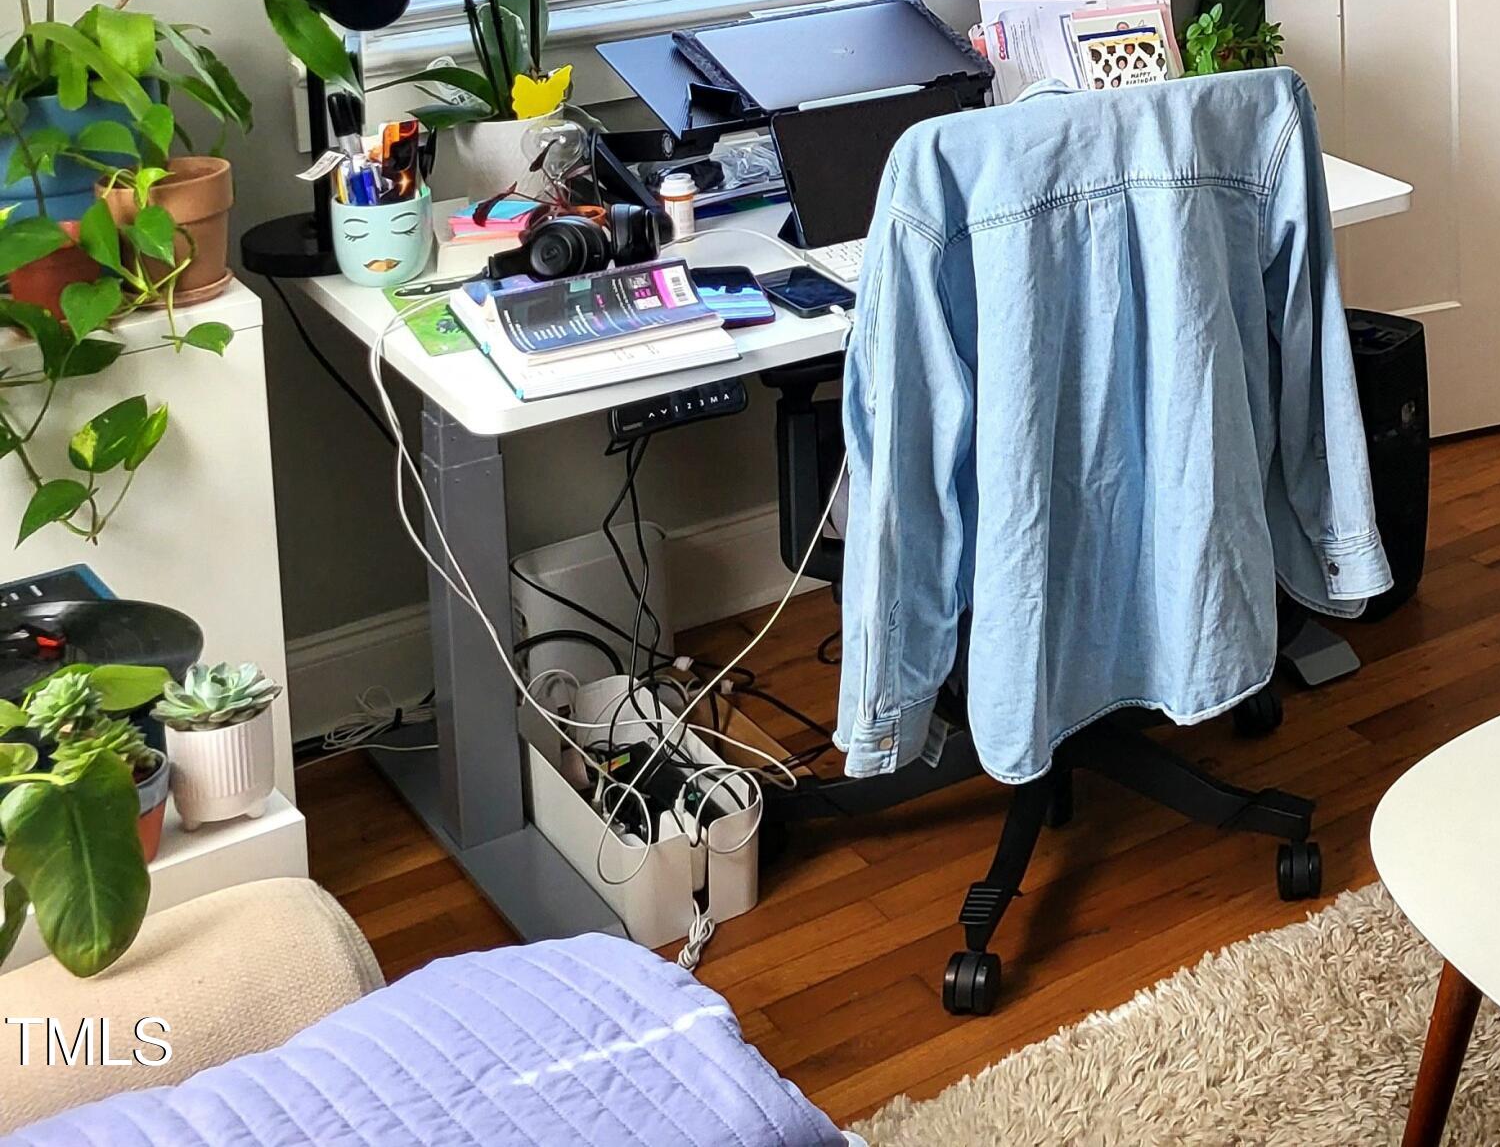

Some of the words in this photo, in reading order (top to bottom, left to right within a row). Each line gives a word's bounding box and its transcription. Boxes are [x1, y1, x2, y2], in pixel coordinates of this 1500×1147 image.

[1130, 71, 1151, 79] HAPPY
[1126, 76, 1157, 85] BIRTHDAY
[710, 396, 718, 404] M
[723, 393, 730, 401] A
